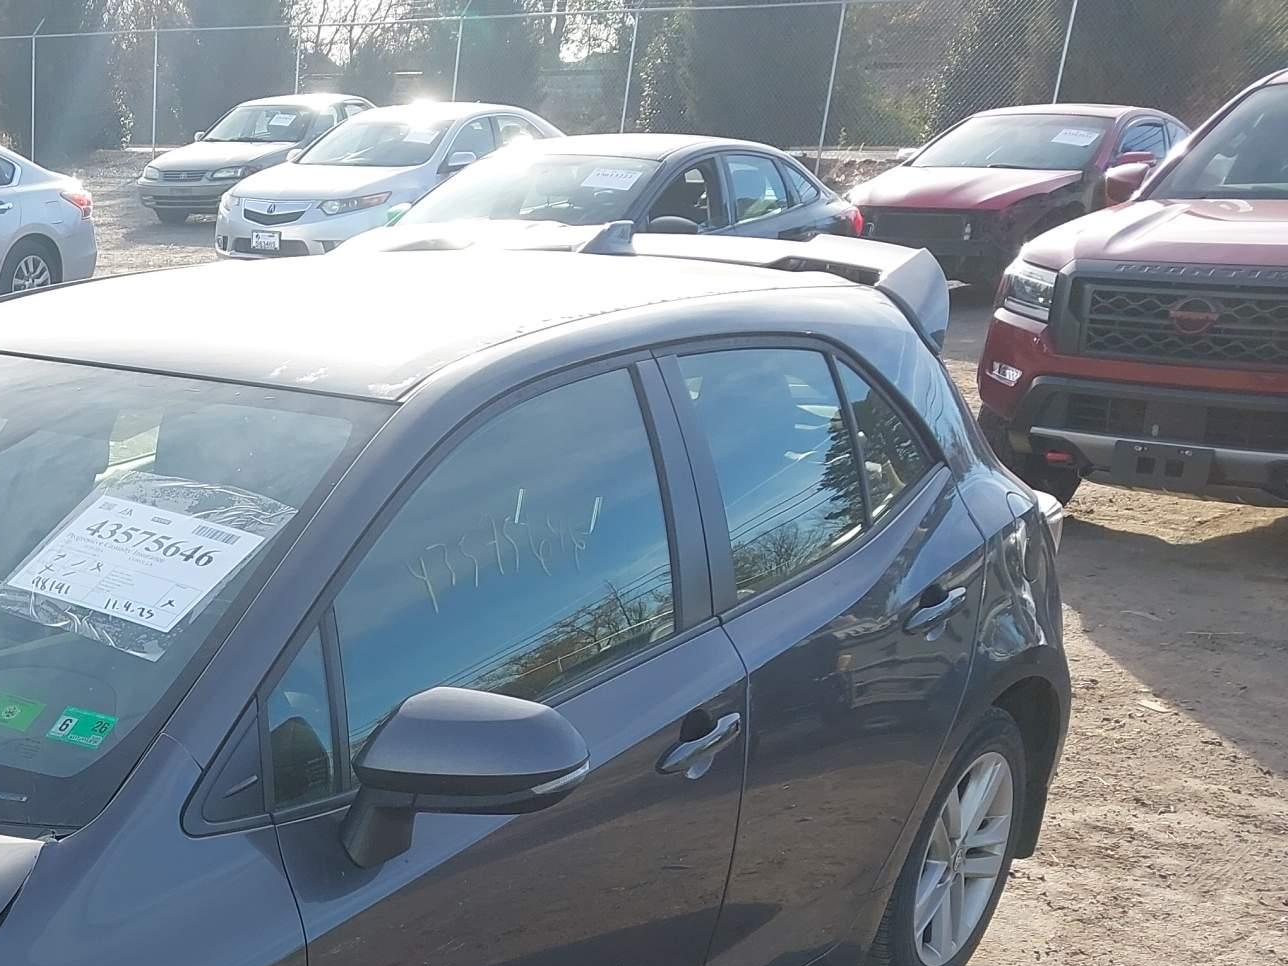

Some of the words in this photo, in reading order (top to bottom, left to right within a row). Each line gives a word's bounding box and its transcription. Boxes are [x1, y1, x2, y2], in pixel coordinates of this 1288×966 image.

[86, 519, 222, 568] 43575646
[58, 718, 73, 732] 6
[91, 720, 111, 734] 26
